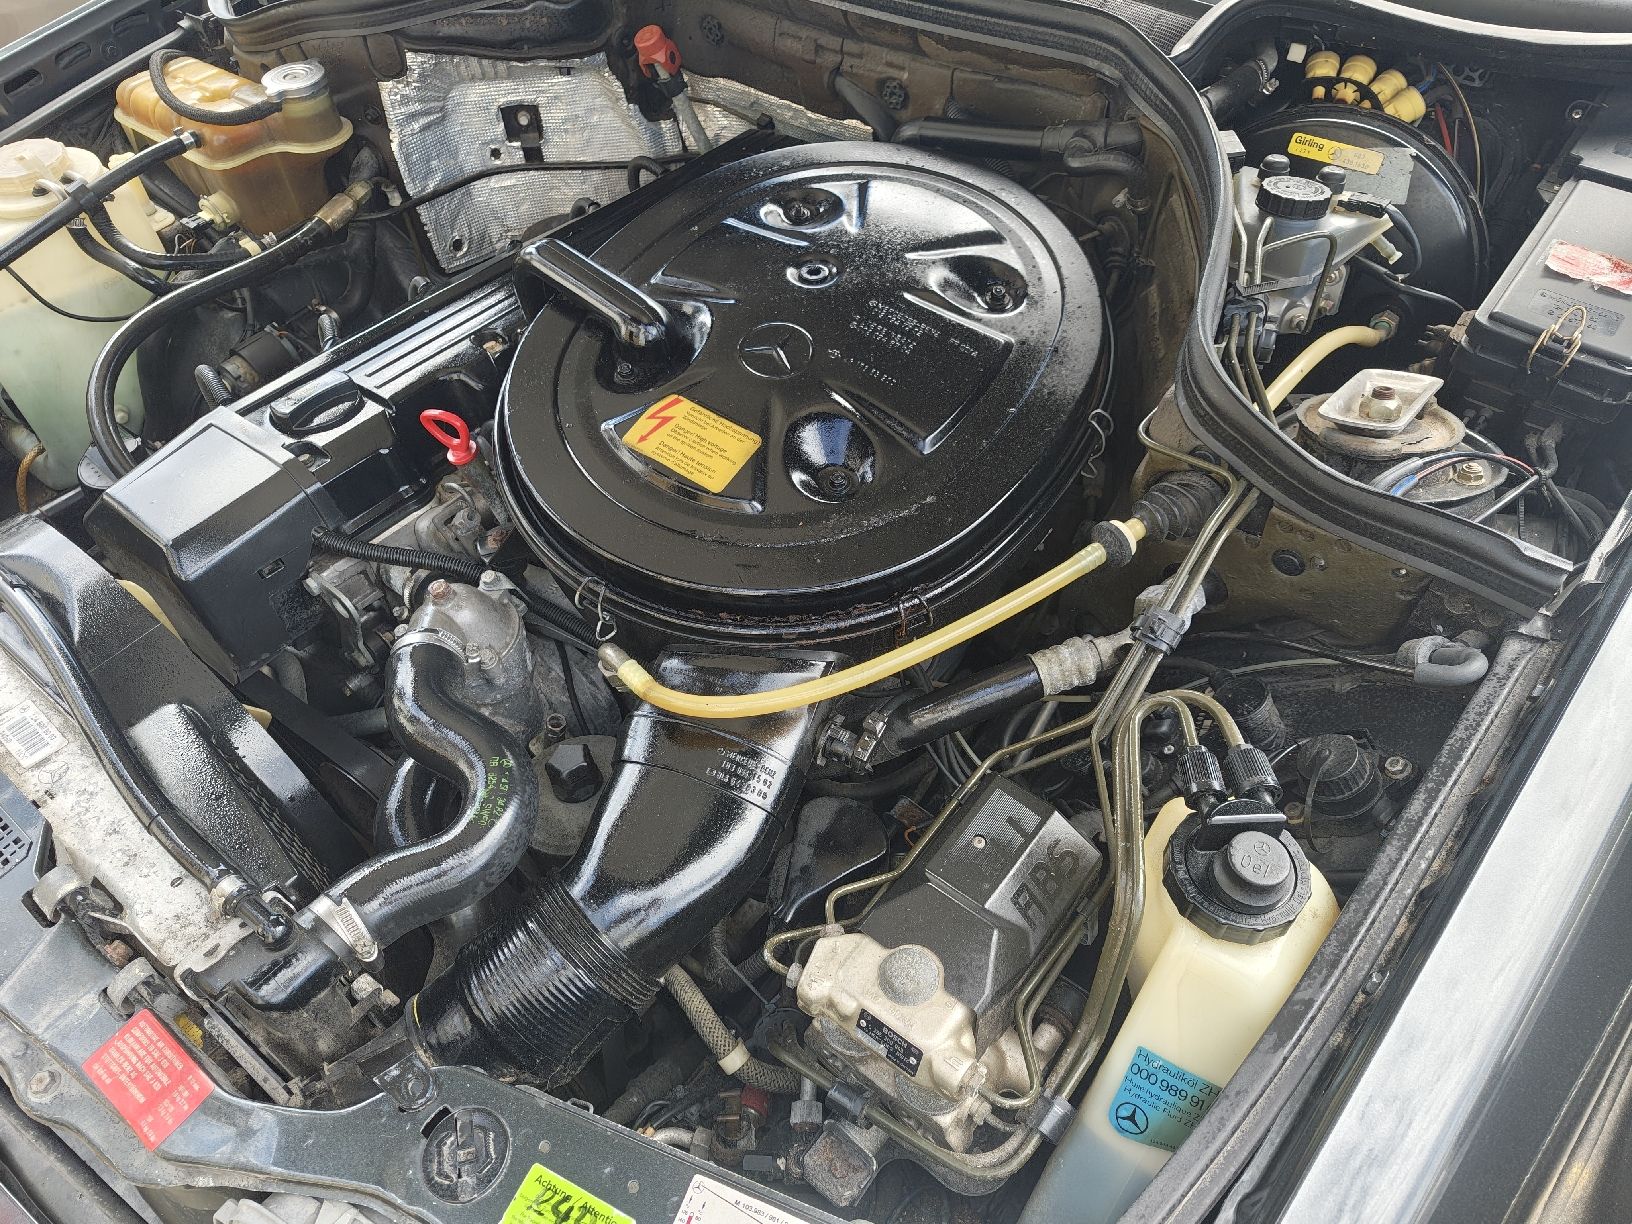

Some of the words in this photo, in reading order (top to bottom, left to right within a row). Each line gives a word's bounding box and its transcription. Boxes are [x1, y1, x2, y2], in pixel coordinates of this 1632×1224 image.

[1295, 136, 1325, 151] Girling
[675, 424, 695, 438] Danger!
[695, 435, 708, 445] High
[708, 442, 728, 455] voltage
[660, 441, 680, 455] Danger!
[681, 452, 696, 463] Haute
[697, 461, 717, 475] tension
[719, 454, 737, 466] working
[1240, 854, 1270, 878] Oel
[1010, 838, 1080, 930] ABS
[882, 1027, 909, 1049] BOSCH
[1137, 1050, 1198, 1089] Hydrauliköl
[1131, 1064, 1157, 1085] 000
[1161, 1080, 1187, 1100] 989
[1191, 1096, 1204, 1110] 91
[1146, 1089, 1192, 1116] hydraulique
[1163, 1108, 1182, 1123] Fluid
